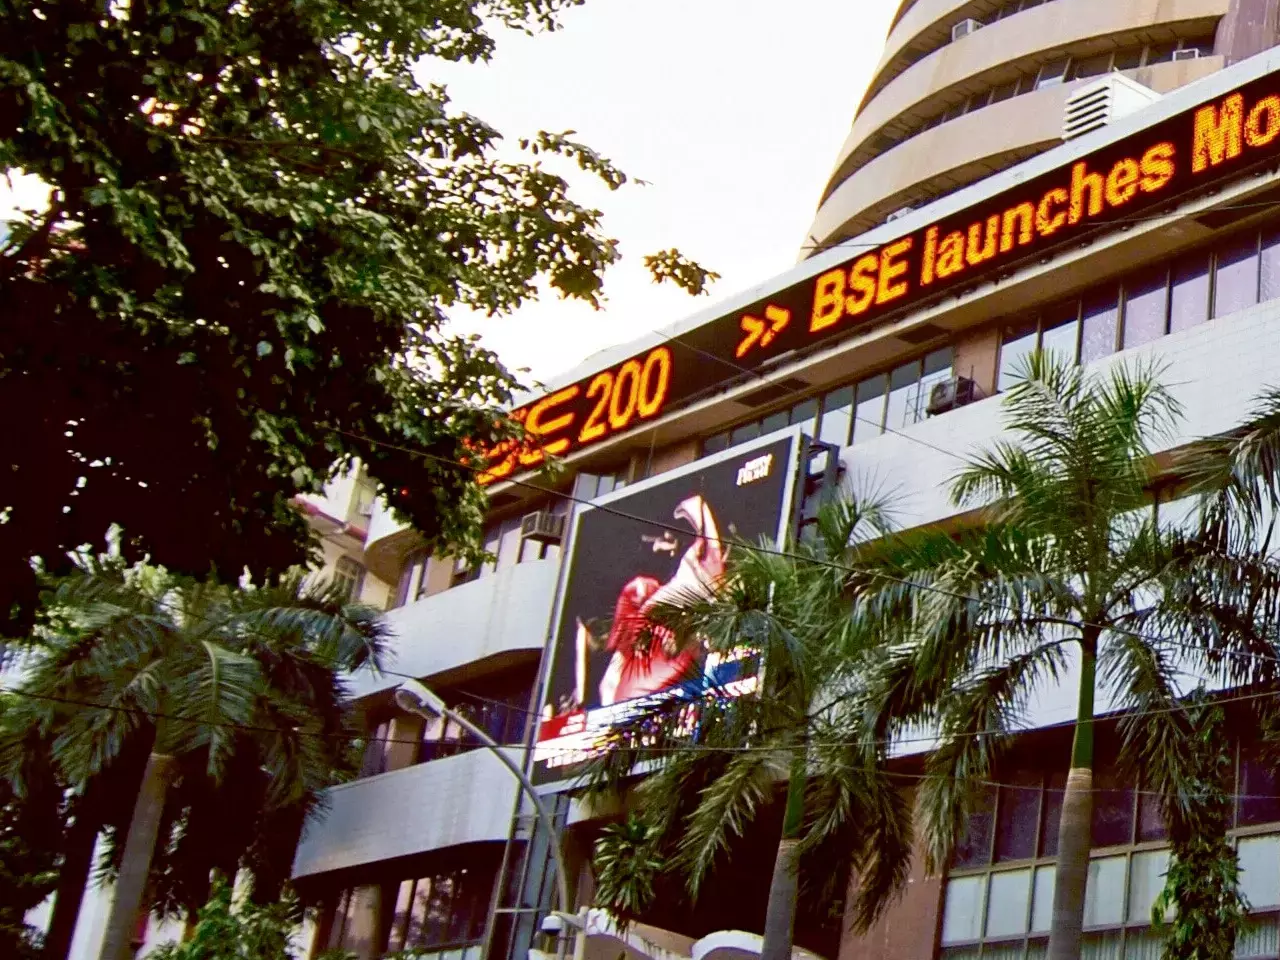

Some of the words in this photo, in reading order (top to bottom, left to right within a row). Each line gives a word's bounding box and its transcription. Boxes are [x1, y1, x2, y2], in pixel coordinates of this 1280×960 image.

[577, 346, 671, 443] 200
[809, 238, 911, 331] BSE
[920, 142, 1175, 285] launches
